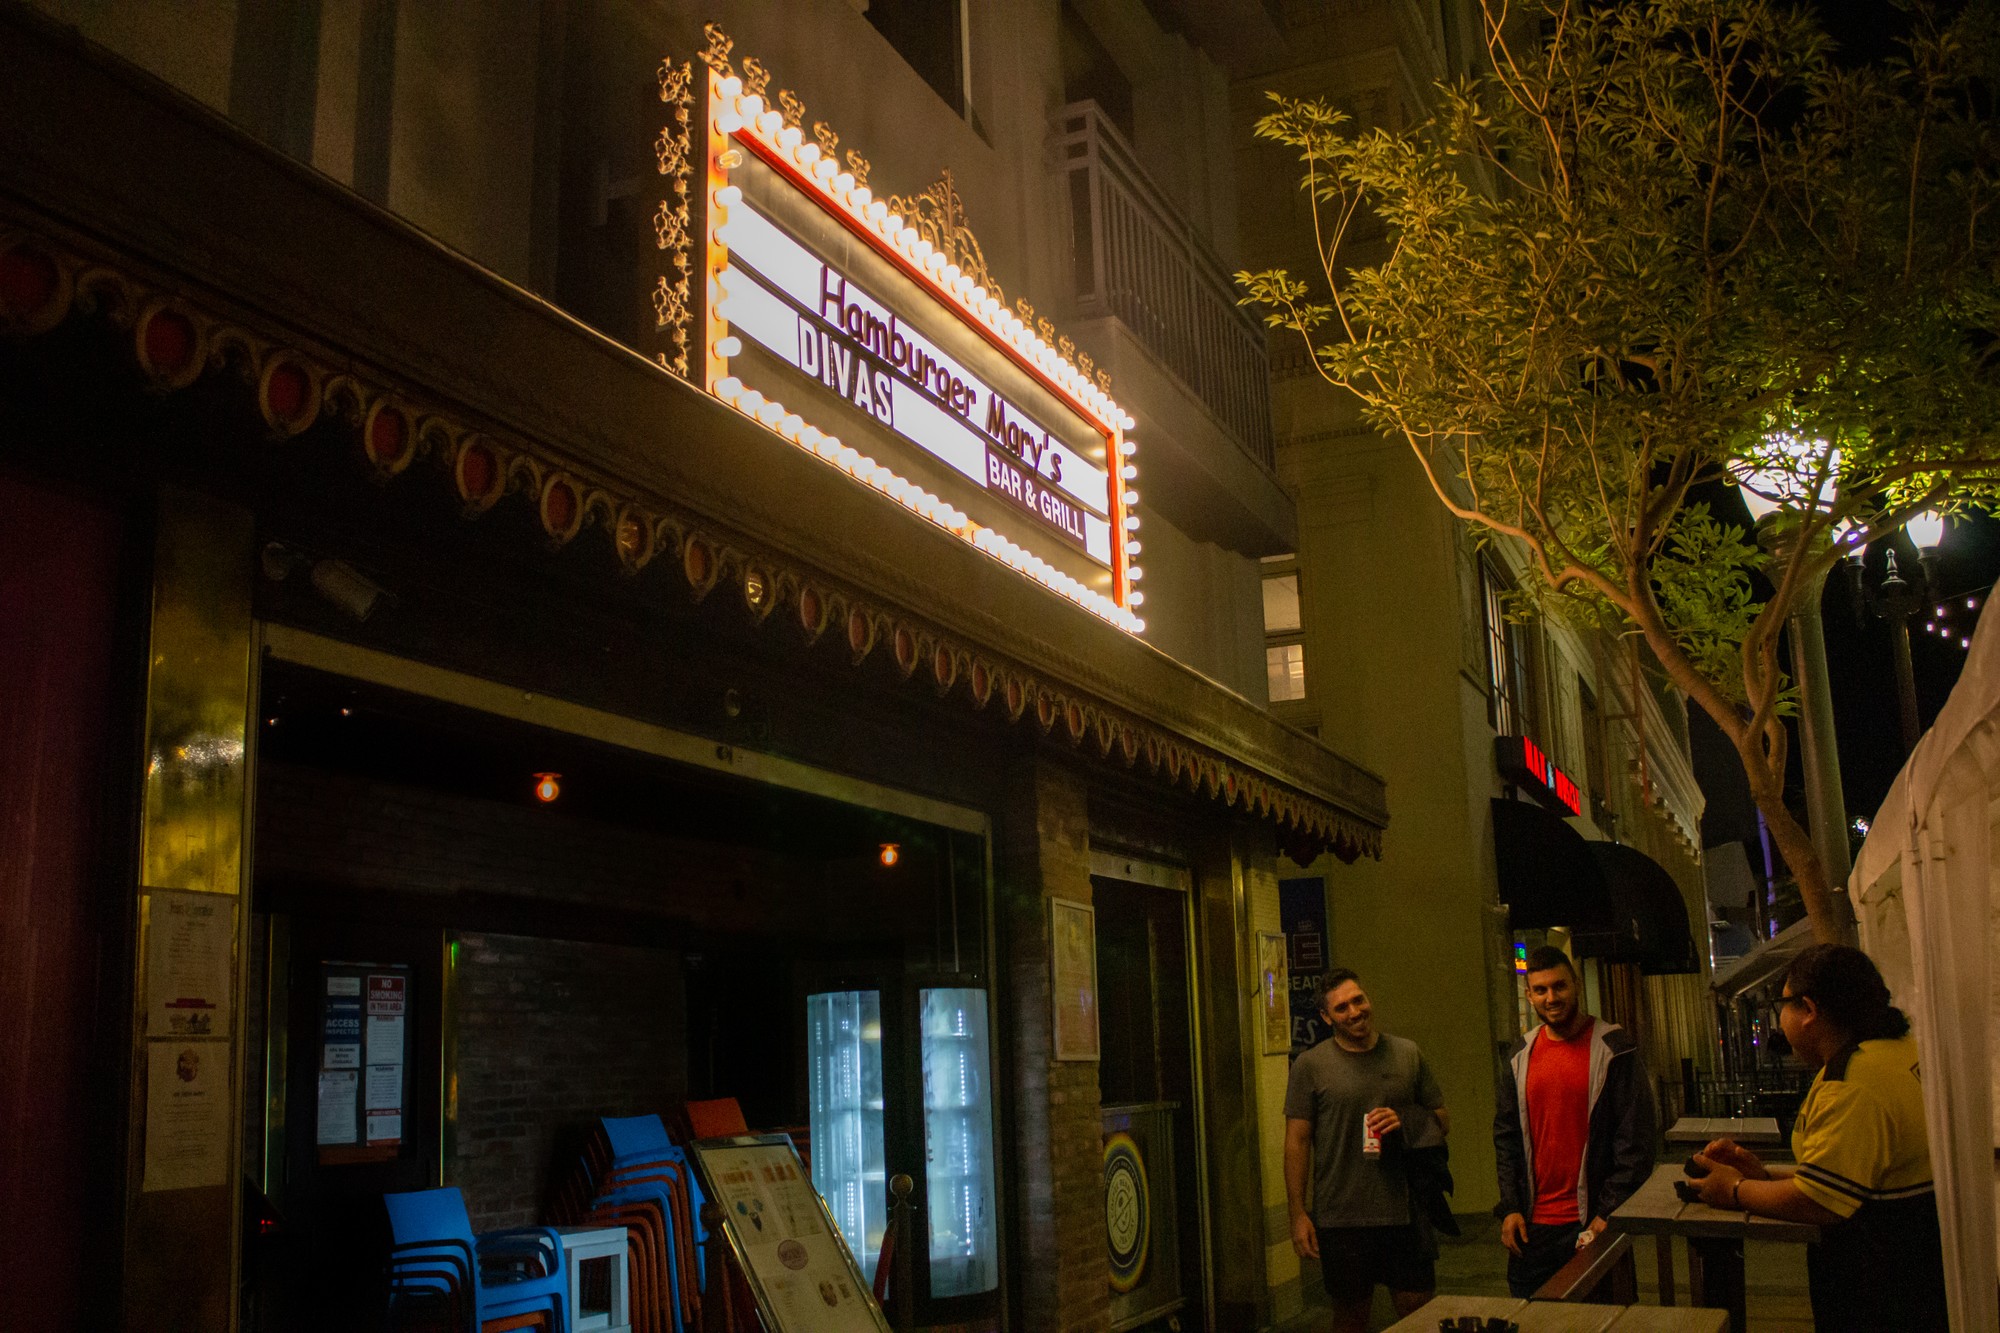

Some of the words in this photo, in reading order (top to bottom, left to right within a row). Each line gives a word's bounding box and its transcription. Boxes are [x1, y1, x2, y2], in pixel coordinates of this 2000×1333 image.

[800, 320, 893, 427] DIVAS
[820, 263, 977, 418] Hamburger
[985, 393, 1063, 484] Mary's
[988, 453, 1022, 502] BAR
[1025, 479, 1037, 511] &
[1040, 491, 1084, 540] GRILL
[381, 979, 392, 989] NO
[370, 990, 402, 1000] SMOKING
[377, 1002, 388, 1010] THIS
[390, 1002, 402, 1010] AREA
[325, 1019, 359, 1028] ACCESS
